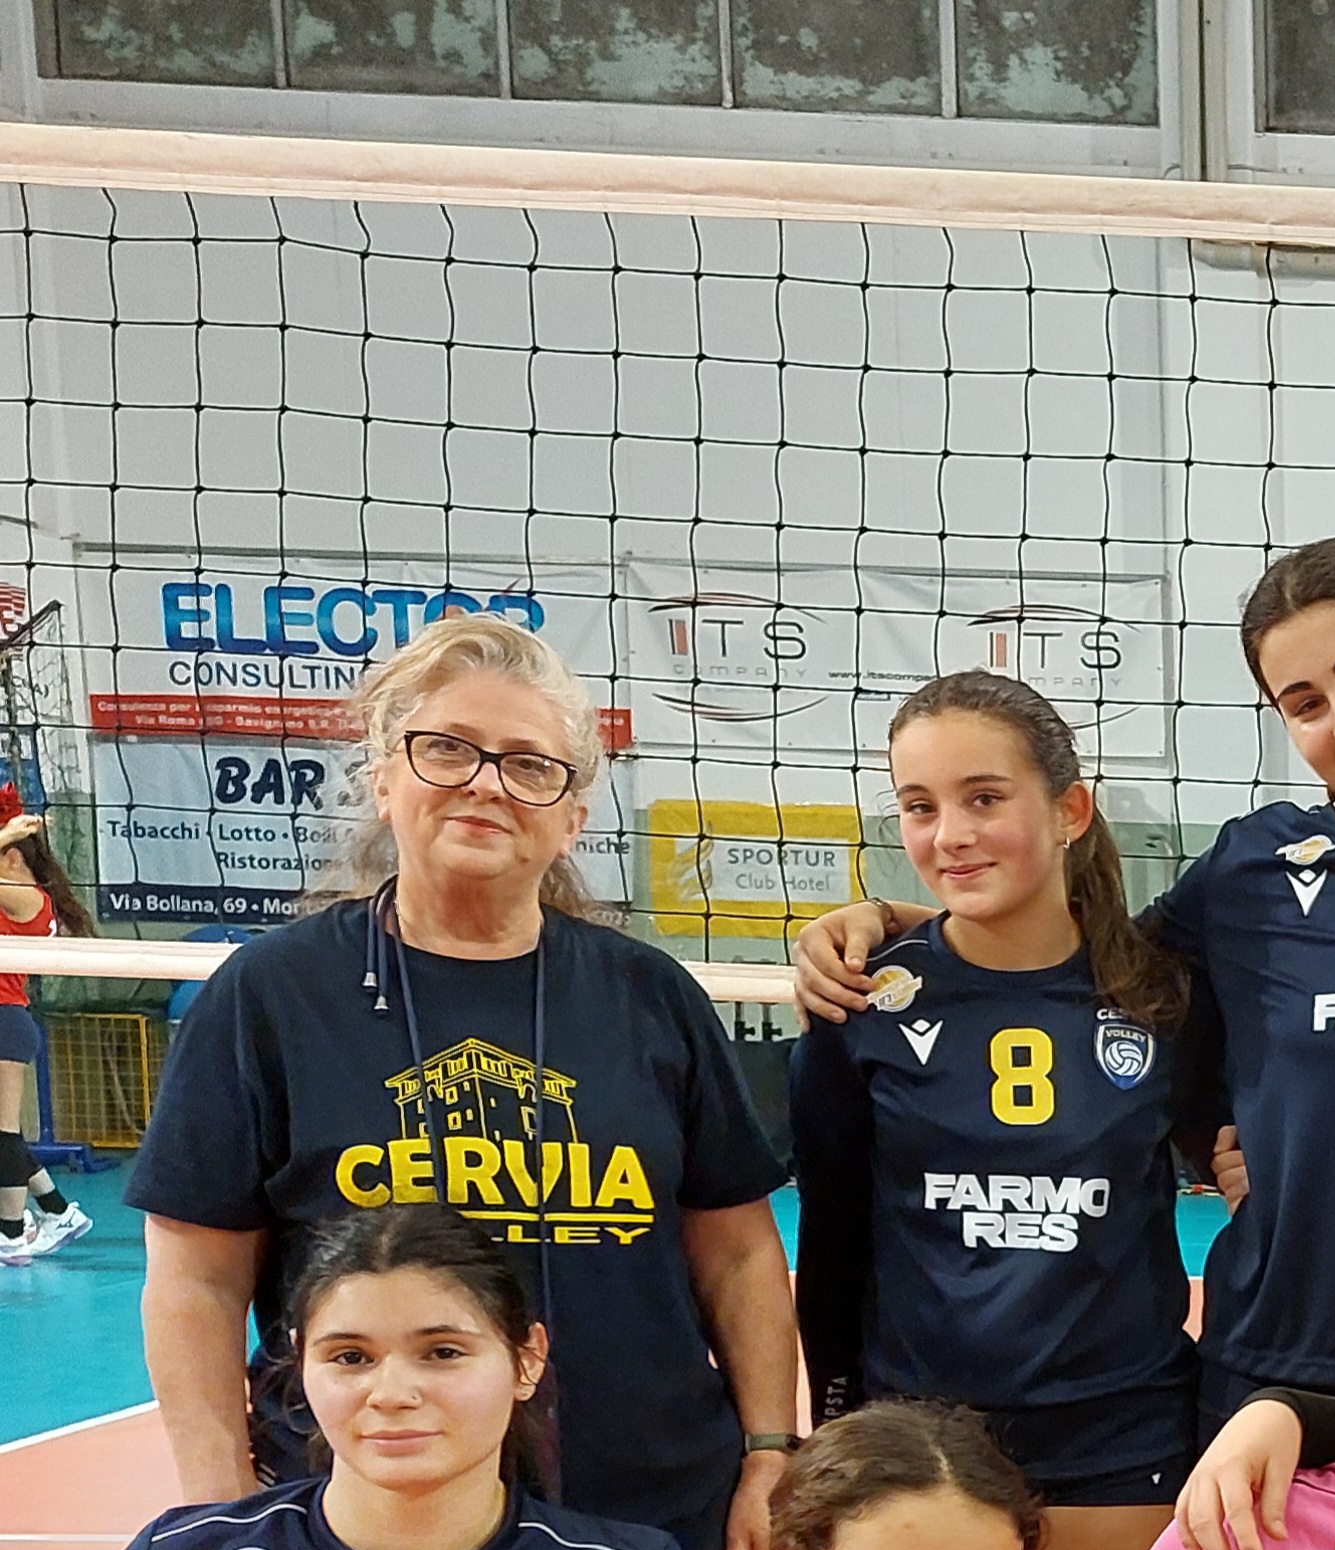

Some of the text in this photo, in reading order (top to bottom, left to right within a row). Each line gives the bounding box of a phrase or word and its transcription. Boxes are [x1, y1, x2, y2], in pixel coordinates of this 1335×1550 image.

[168, 661, 366, 690] CONSULTIN
[214, 756, 324, 811] BAR
[107, 820, 200, 841] Tabacchi
[218, 824, 276, 843] Lotto
[727, 847, 836, 868] SPORTUR
[735, 873, 830, 892] Club Hotel
[110, 893, 141, 912] Via
[223, 899, 247, 914] 69
[990, 1027, 1055, 1126] 8
[335, 1135, 656, 1209] CERVIA
[923, 1172, 1111, 1217] FARMO
[962, 1211, 1079, 1252] RES
[824, 1376, 848, 1416] PSTA
